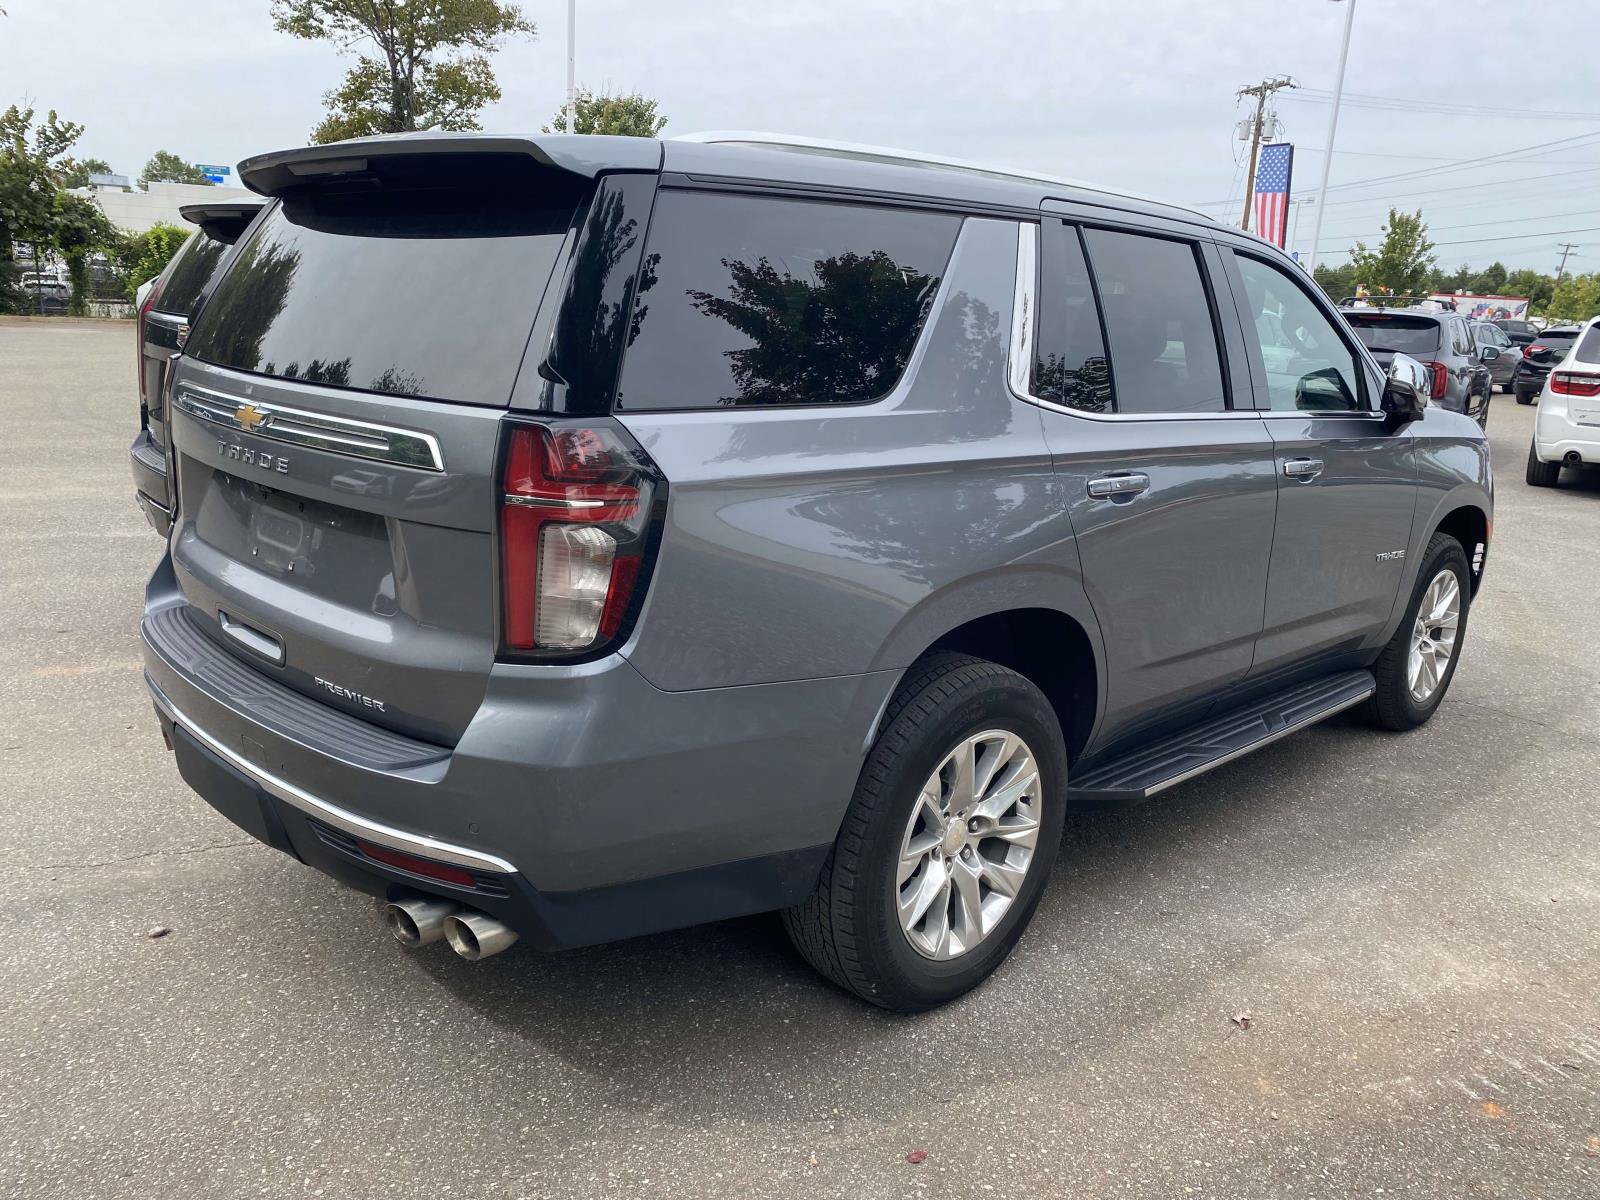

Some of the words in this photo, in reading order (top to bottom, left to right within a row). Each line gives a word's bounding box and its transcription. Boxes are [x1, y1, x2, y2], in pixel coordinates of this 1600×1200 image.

[217, 440, 289, 474] TAHOE
[1376, 549, 1405, 562] TAHOE
[314, 676, 386, 712] PREMIER
